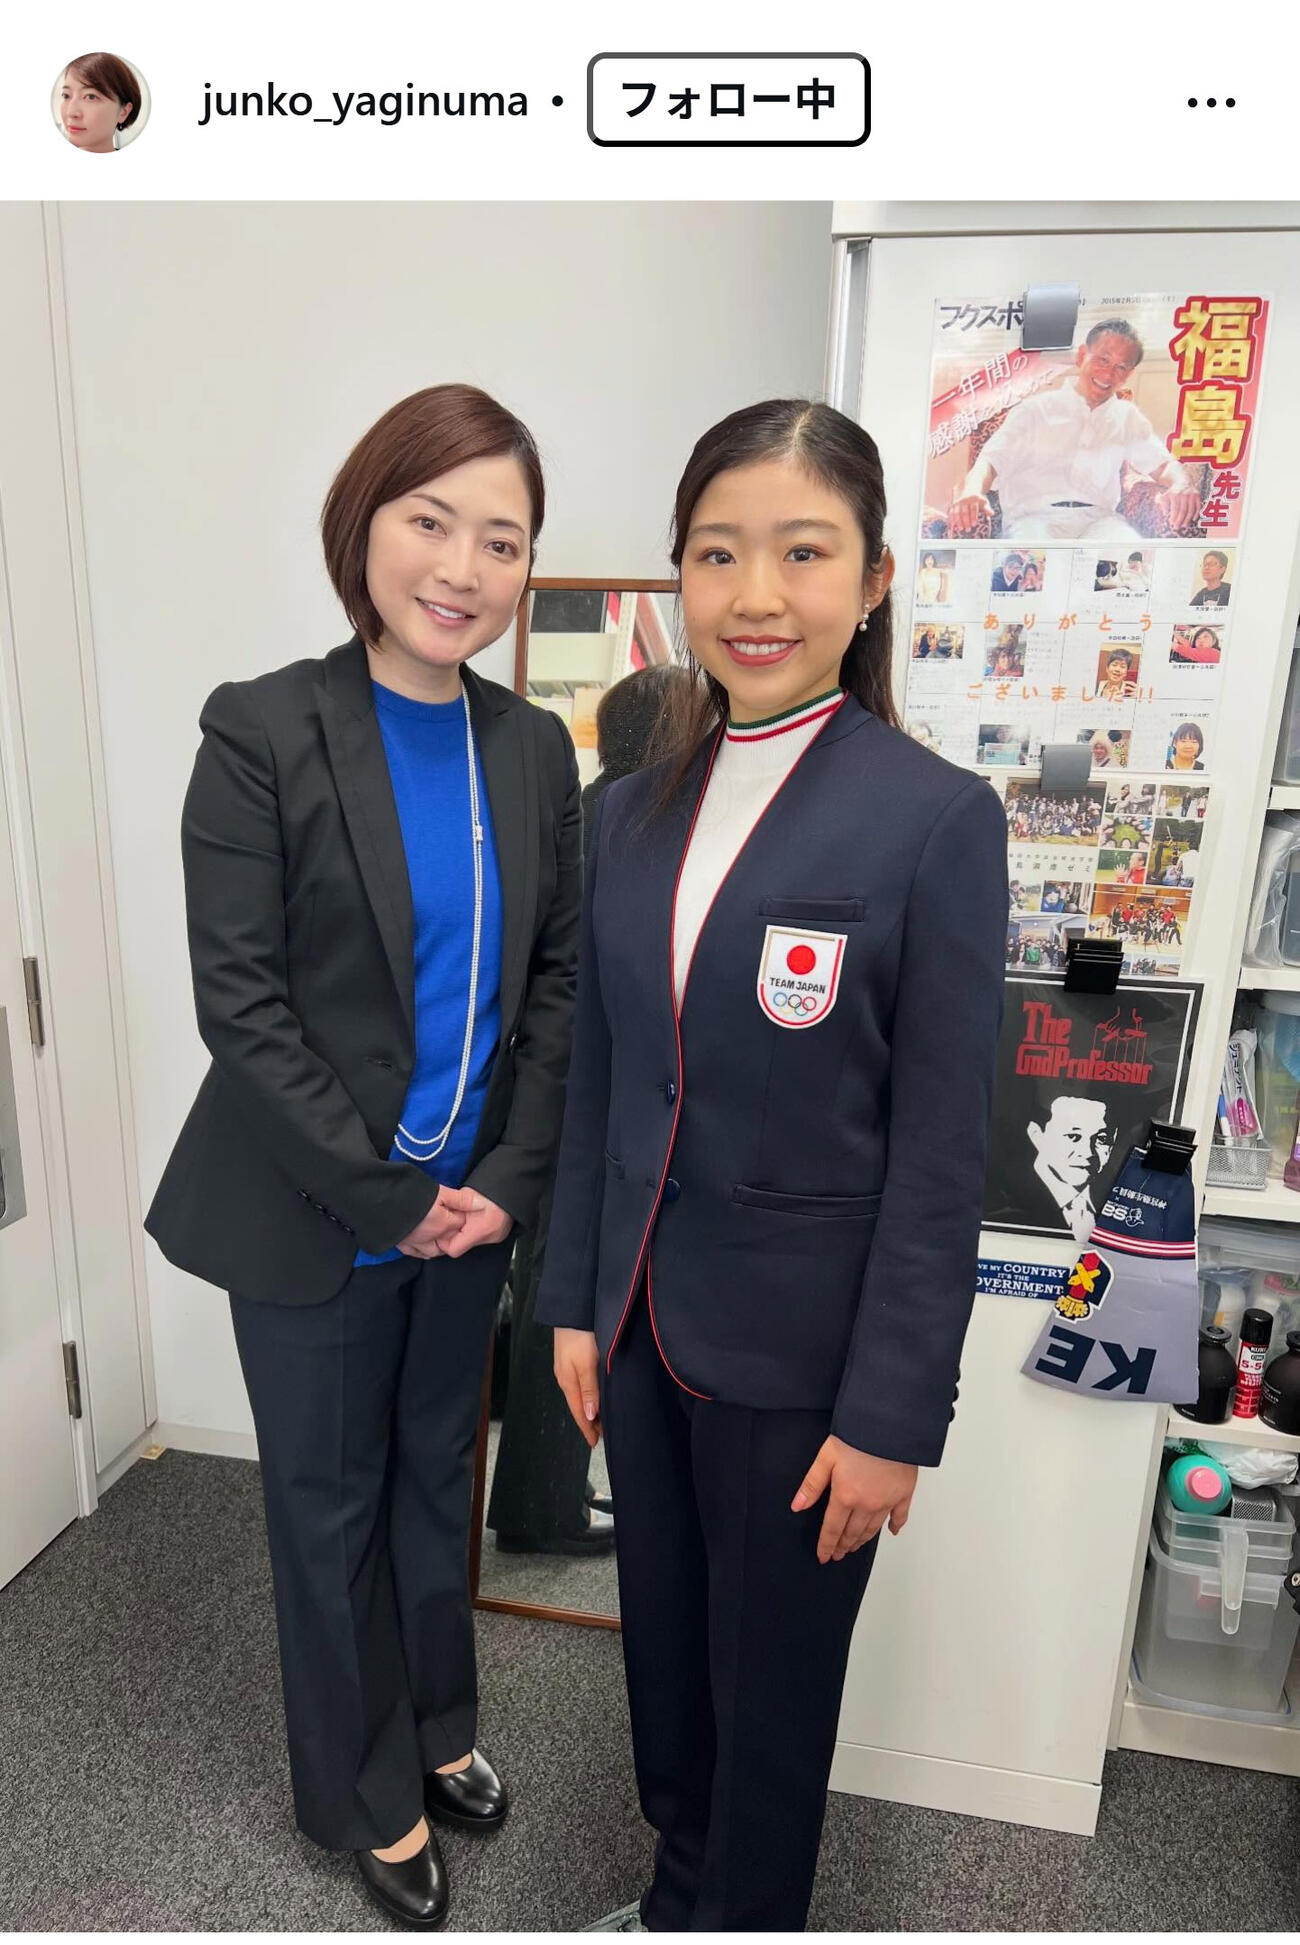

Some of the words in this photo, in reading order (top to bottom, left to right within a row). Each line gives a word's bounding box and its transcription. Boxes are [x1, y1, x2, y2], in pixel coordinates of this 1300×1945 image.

[1170, 297, 1262, 468] 福島
[1200, 471, 1241, 527] 先生
[769, 977, 795, 990] TEAM
[795, 981, 826, 994] JAPAN
[1022, 1001, 1073, 1045] The
[1015, 1043, 1153, 1085] GodProfessor
[1003, 1263, 1066, 1279] COUNTRY
[1013, 1274, 1030, 1282] THE
[976, 1276, 1065, 1296] OVERNMENT.
[999, 1288, 1026, 1298] AFRAID
[1241, 1359, 1265, 1371] 5-5
